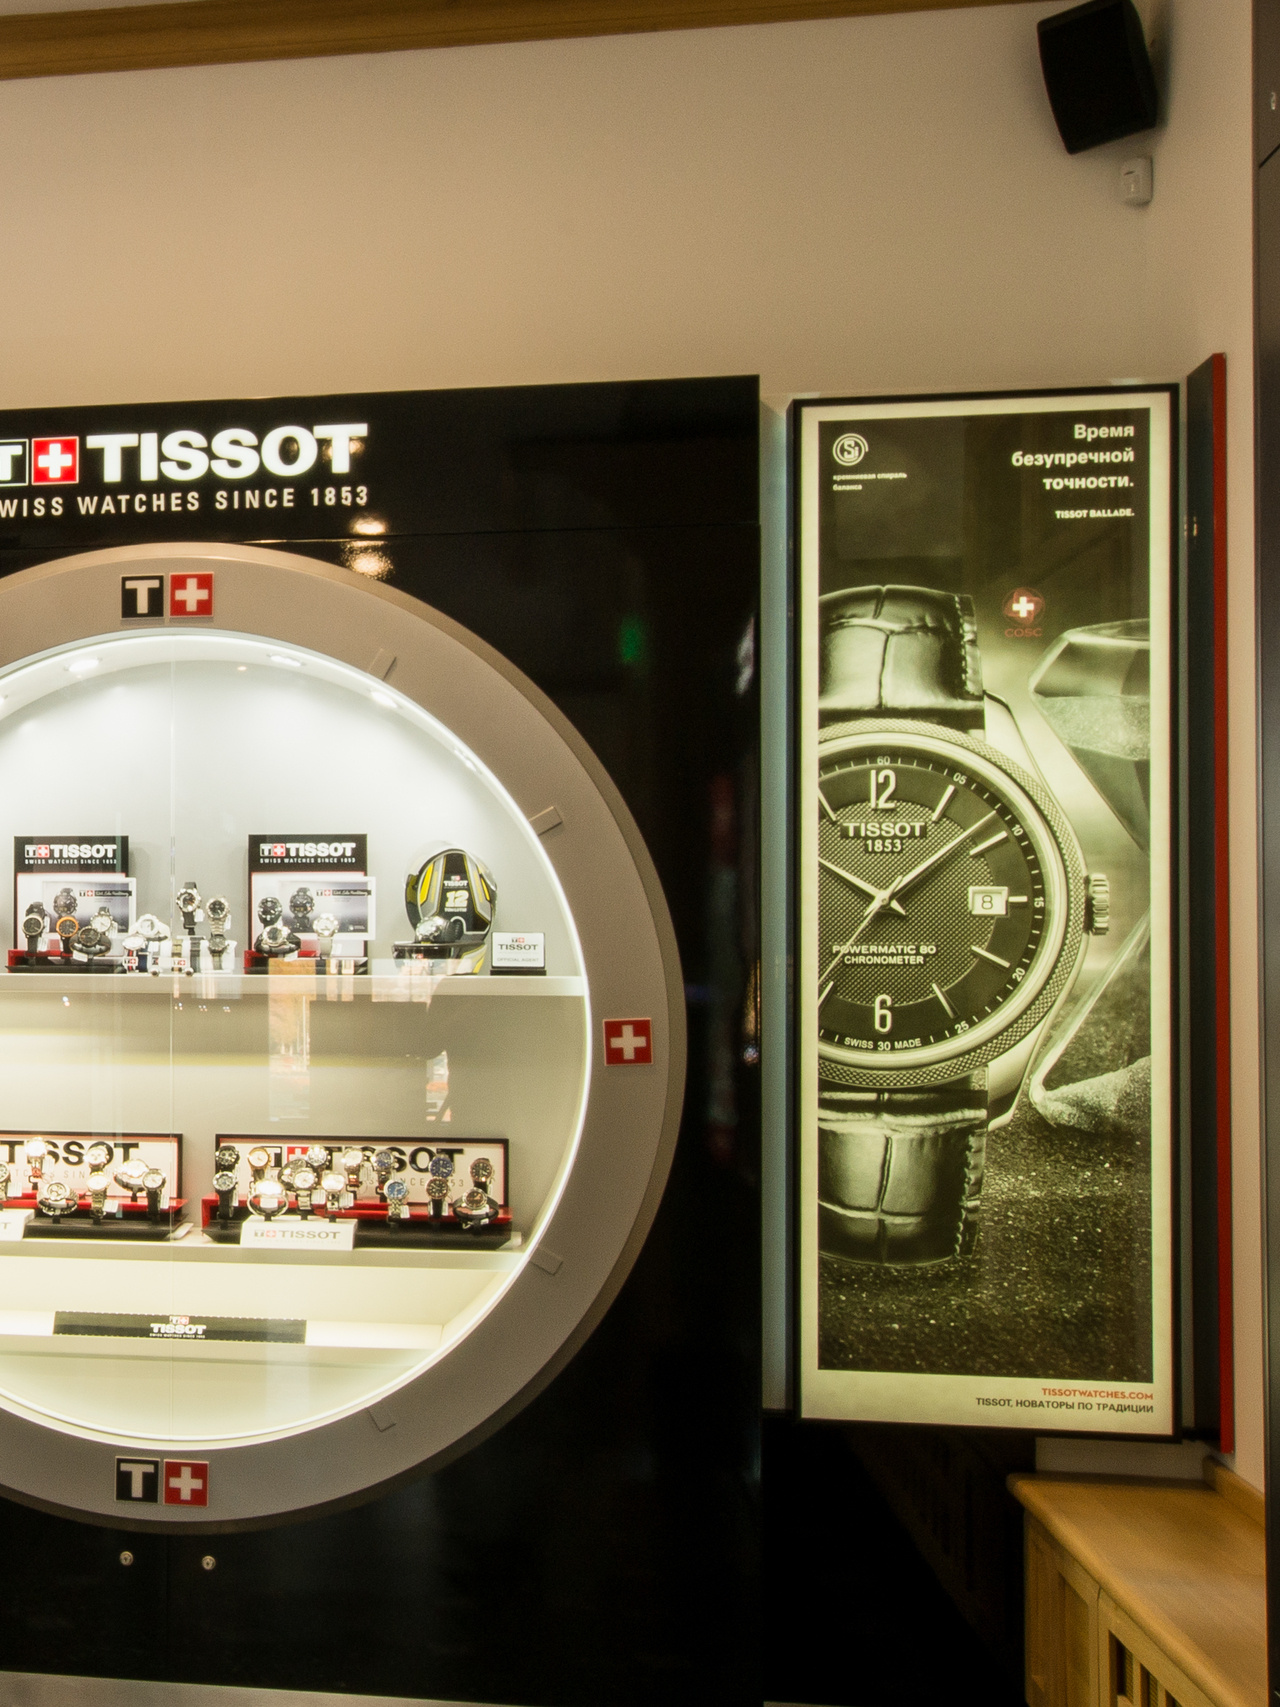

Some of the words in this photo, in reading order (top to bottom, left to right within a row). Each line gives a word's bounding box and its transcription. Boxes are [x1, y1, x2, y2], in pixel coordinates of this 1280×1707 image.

[1073, 423, 1135, 442] Время
[85, 423, 368, 482] TISSOT
[1011, 447, 1135, 468] безупречной
[1043, 474, 1135, 490] точности.
[77, 491, 200, 515] WATCHES
[215, 488, 295, 510] SINCE
[310, 485, 369, 507] 1853
[1055, 509, 1088, 519] TISSOT
[1089, 508, 1135, 518] BALLADE.
[1004, 627, 1043, 638] COSC
[877, 755, 891, 765] 60
[952, 772, 968, 785] 05
[870, 769, 897, 810] 12
[842, 822, 925, 837] TISSOT
[50, 844, 117, 858] TISSOT
[285, 842, 357, 857] TISSOT
[866, 840, 902, 852] 1853
[445, 889, 469, 908] 12
[981, 895, 993, 910] 8
[1034, 896, 1045, 908] 15
[832, 944, 917, 954] POWERMATIC
[919, 944, 937, 954] 80
[844, 955, 924, 965] CHRONOMETER
[1012, 967, 1027, 981] 20
[874, 994, 893, 1034] 6
[954, 1020, 970, 1035] 25
[844, 1037, 874, 1049] SWISS
[877, 1041, 891, 1051] 30
[894, 1037, 922, 1050] MADE
[0, 1140, 140, 1166] TSSOT
[279, 1231, 341, 1239] TISSOT
[150, 1323, 207, 1334] TISSOT
[1041, 1387, 1154, 1400] TISSOTWATCHES.COM
[976, 1397, 1013, 1408] TISSOT,
[1015, 1399, 1075, 1410] НОВАТОРЫ
[1078, 1402, 1093, 1411] ПО
[1096, 1403, 1154, 1413] ТРАДИЦИИ
